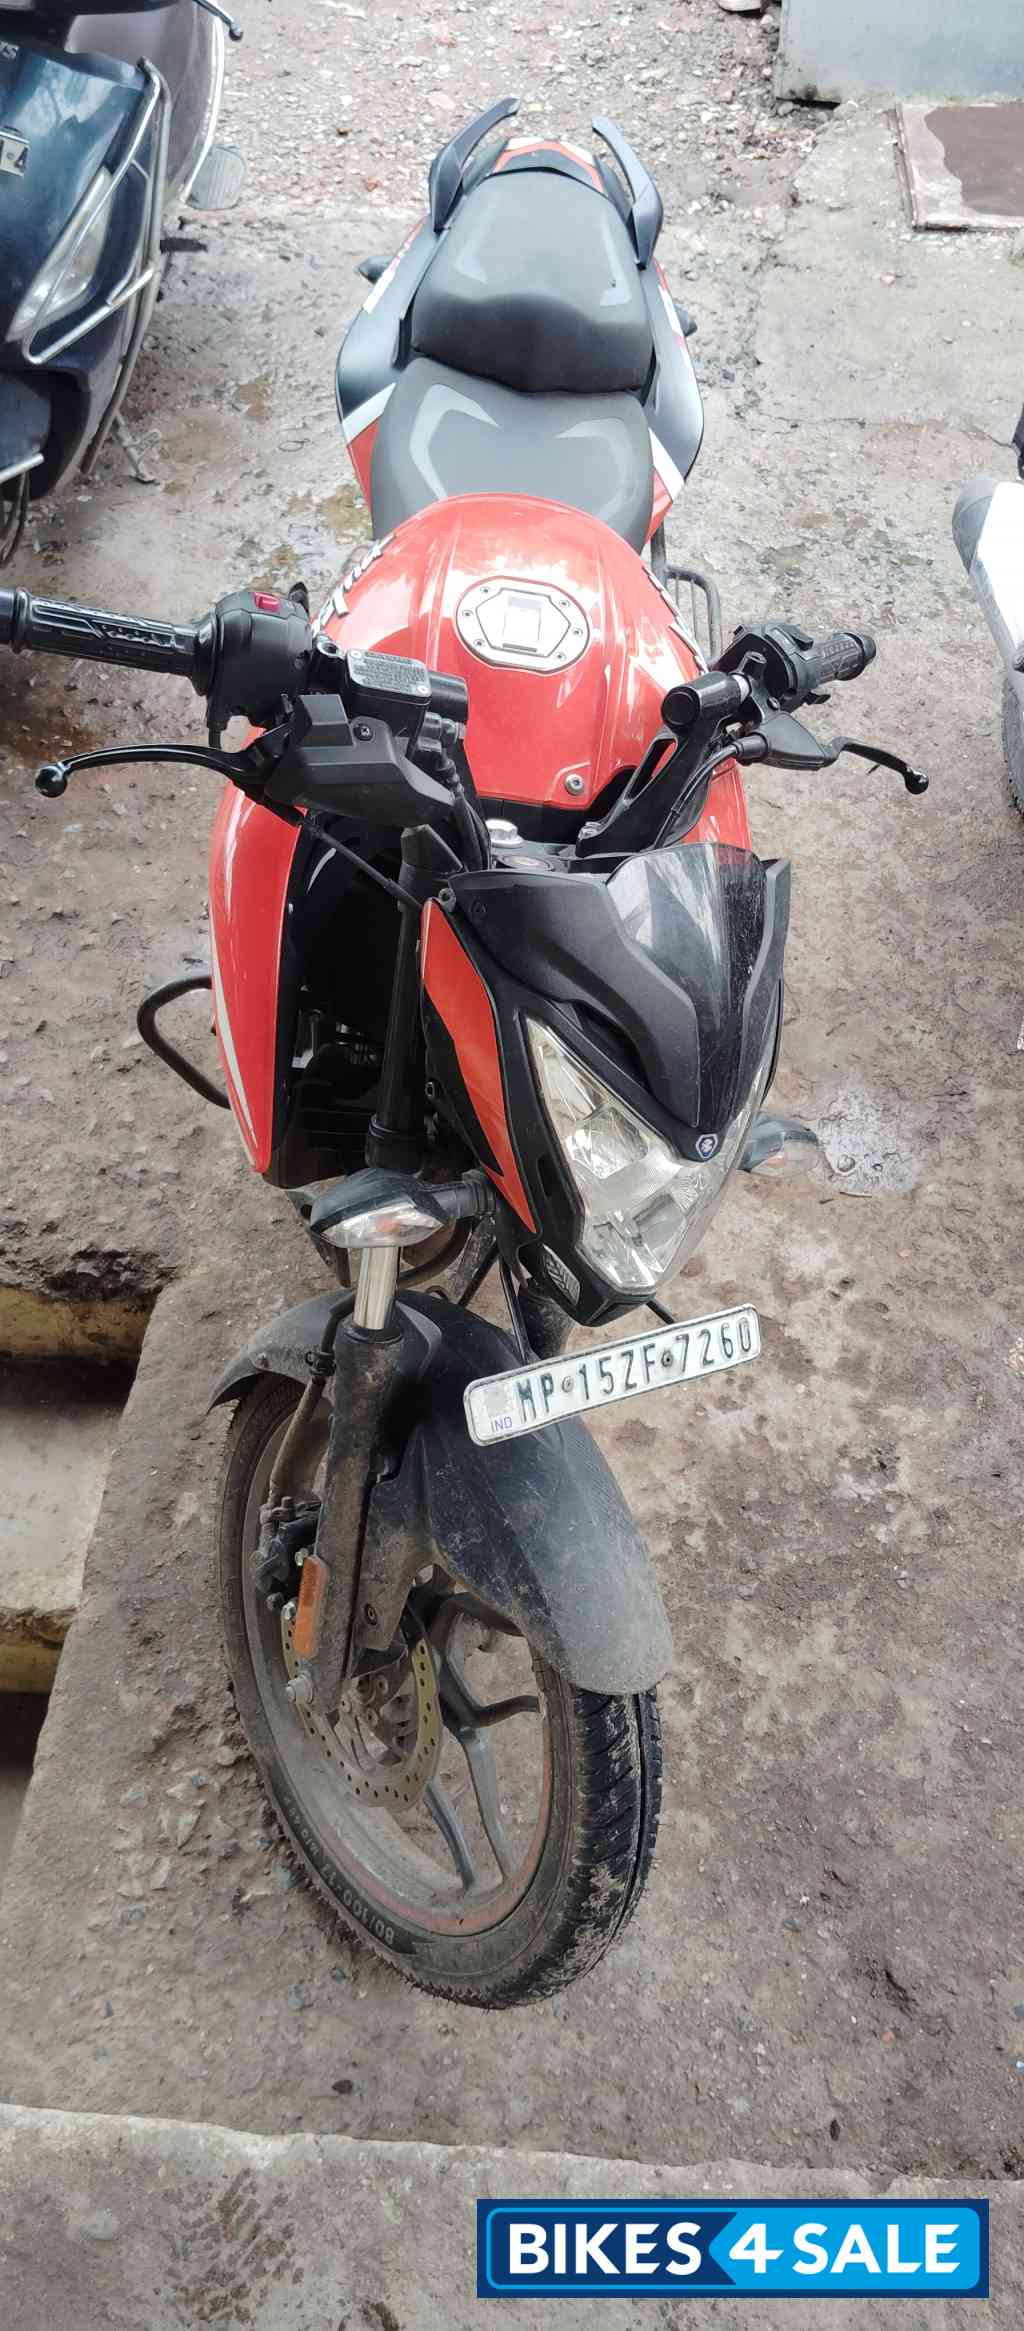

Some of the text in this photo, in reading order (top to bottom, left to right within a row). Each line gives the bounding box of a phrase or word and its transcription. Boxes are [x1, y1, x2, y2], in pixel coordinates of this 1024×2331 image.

[516, 1372, 555, 1423] MP
[675, 1316, 752, 1373] 7260
[490, 1415, 513, 1433] IND
